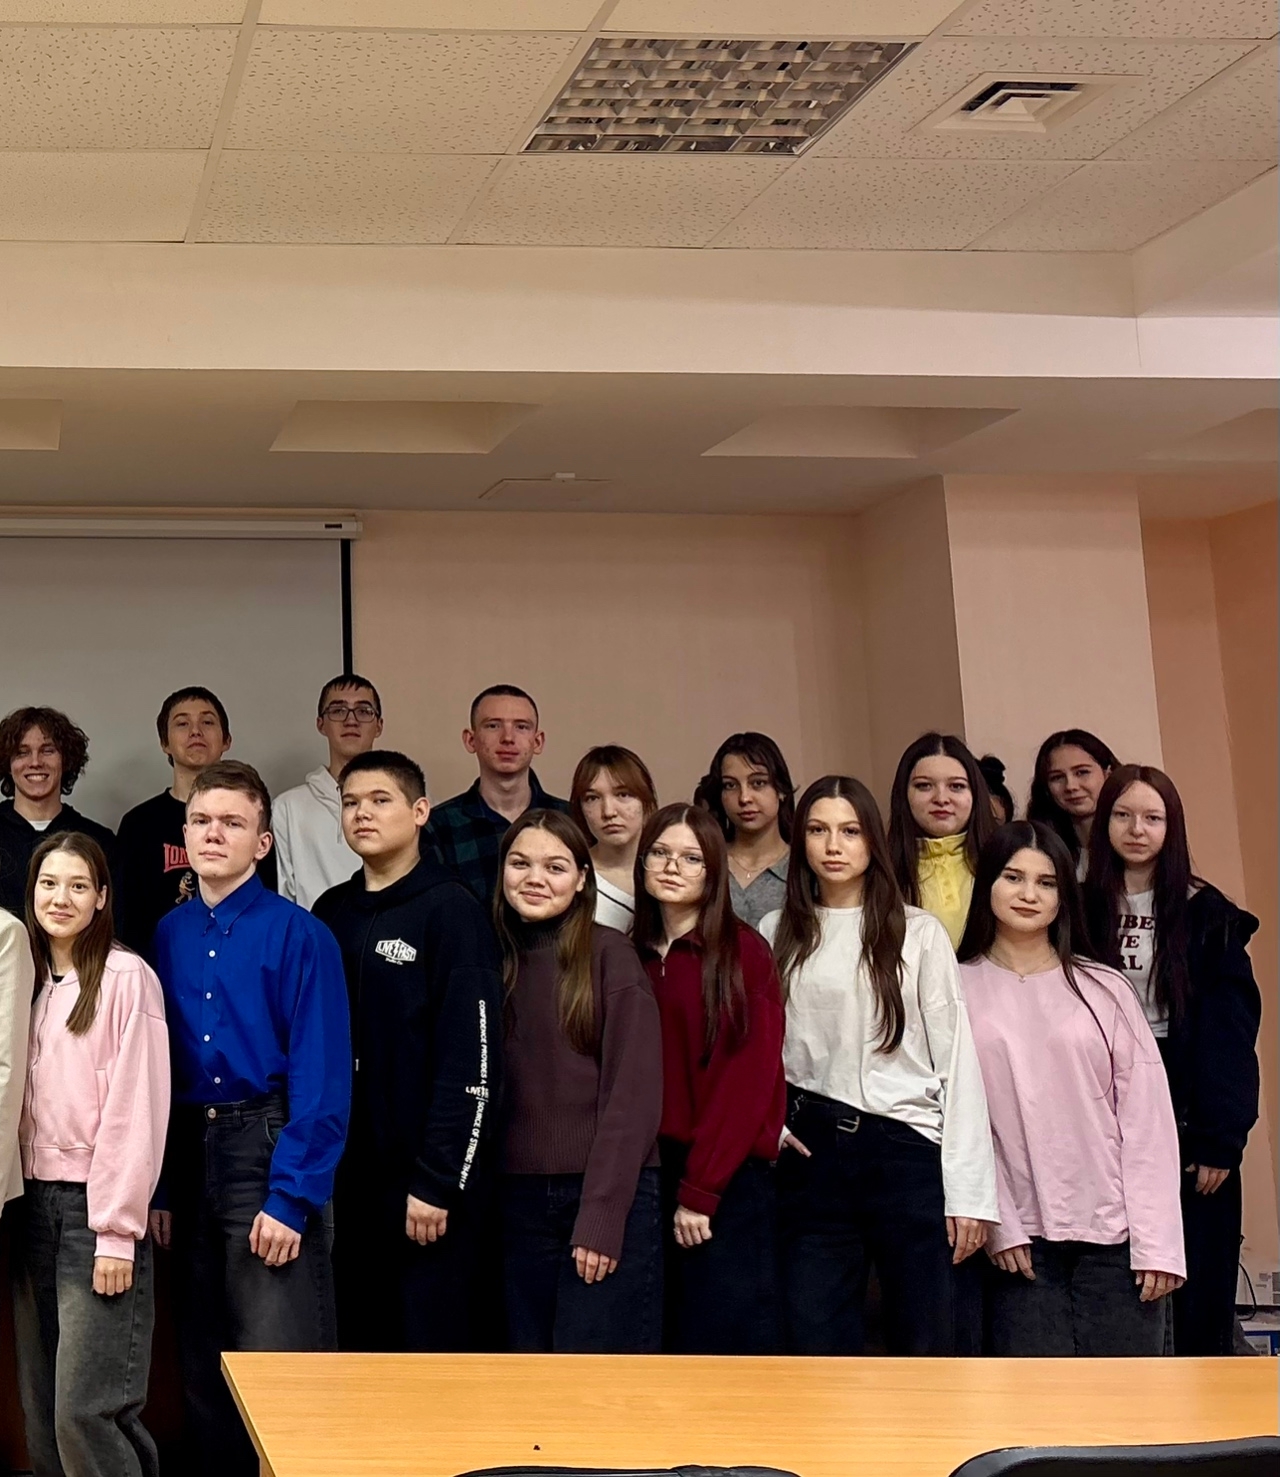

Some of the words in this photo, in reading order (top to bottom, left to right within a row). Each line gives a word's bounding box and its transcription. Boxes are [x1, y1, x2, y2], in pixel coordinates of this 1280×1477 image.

[479, 1000, 487, 1044] CONFIDENCE
[480, 1044, 488, 1079] PROVIDES
[473, 1101, 485, 1128] SOURCE
[471, 1128, 480, 1138] OF
